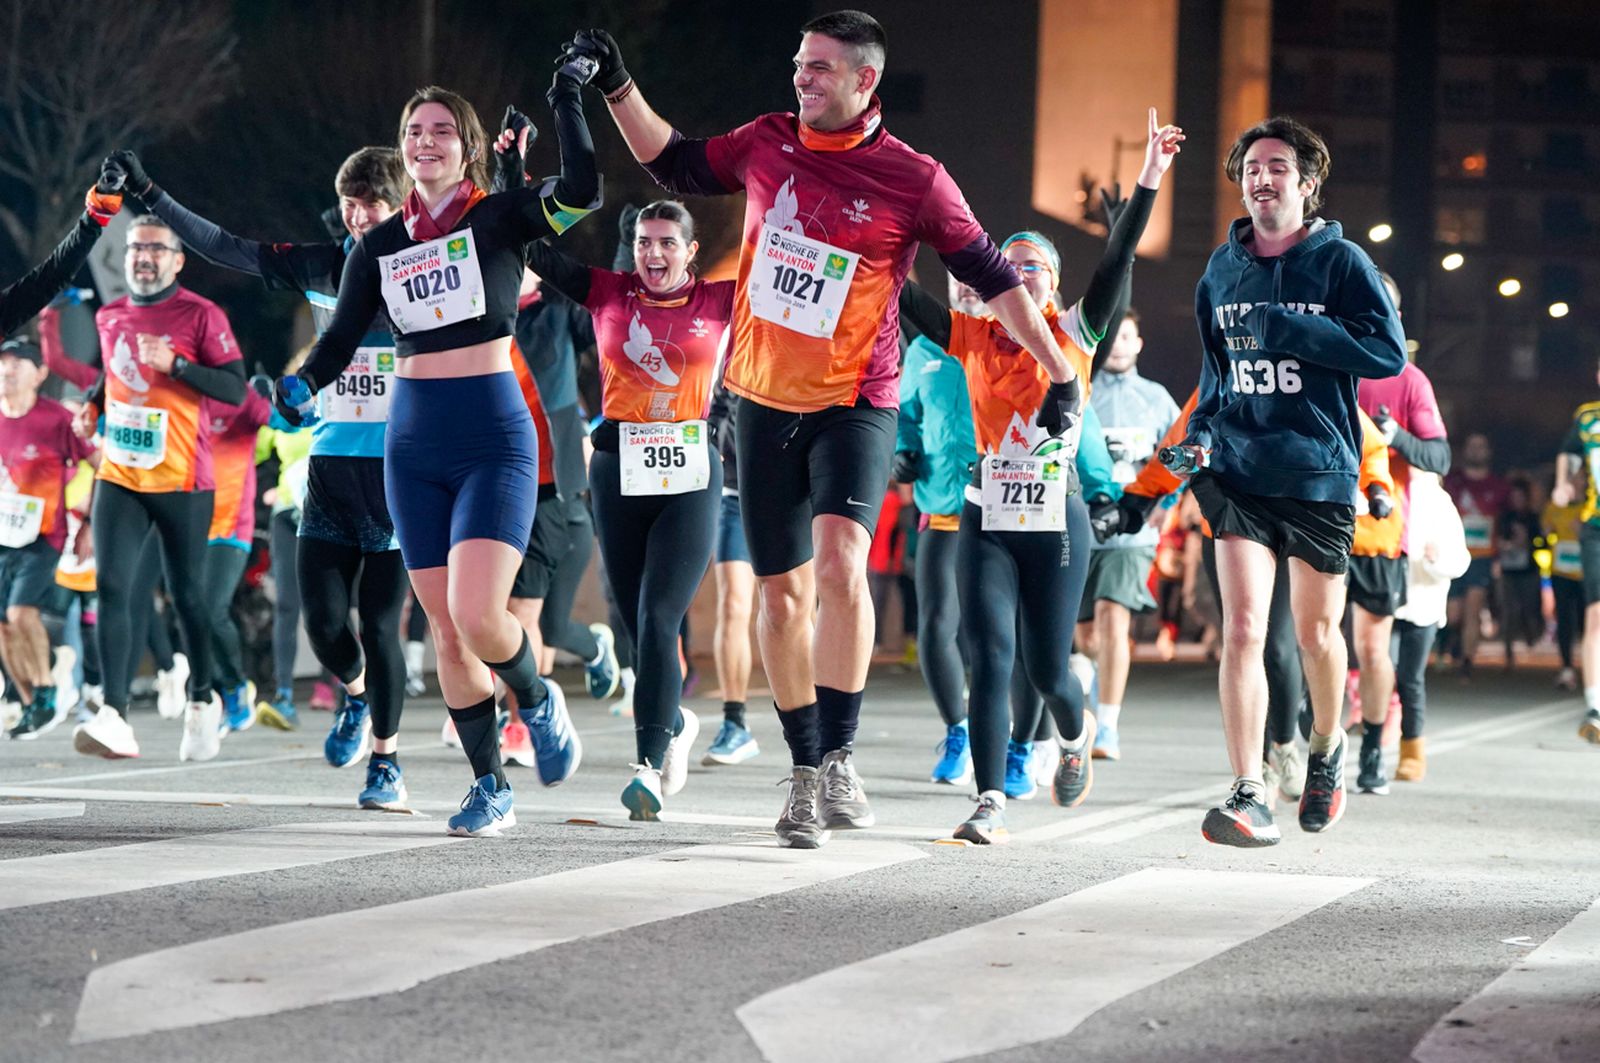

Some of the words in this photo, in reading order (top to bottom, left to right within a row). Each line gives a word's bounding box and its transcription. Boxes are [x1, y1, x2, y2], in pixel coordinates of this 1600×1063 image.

[401, 253, 426, 267] NOCHE
[428, 249, 438, 258] DE
[768, 248, 784, 261] SAN
[780, 241, 807, 257] NOCHE
[807, 249, 819, 260] DE
[392, 267, 410, 281] SAN
[401, 265, 461, 303] 1020
[773, 264, 825, 304] 1021
[640, 351, 662, 373] 43
[336, 375, 386, 397] 6495
[1230, 359, 1302, 394] 1636
[630, 436, 646, 445] SAN
[639, 427, 663, 435] NOCHE
[665, 427, 674, 435] DE
[643, 446, 686, 468] 395
[992, 472, 1008, 480] SAN
[1025, 463, 1035, 471] DE
[1001, 482, 1046, 505] 7212
